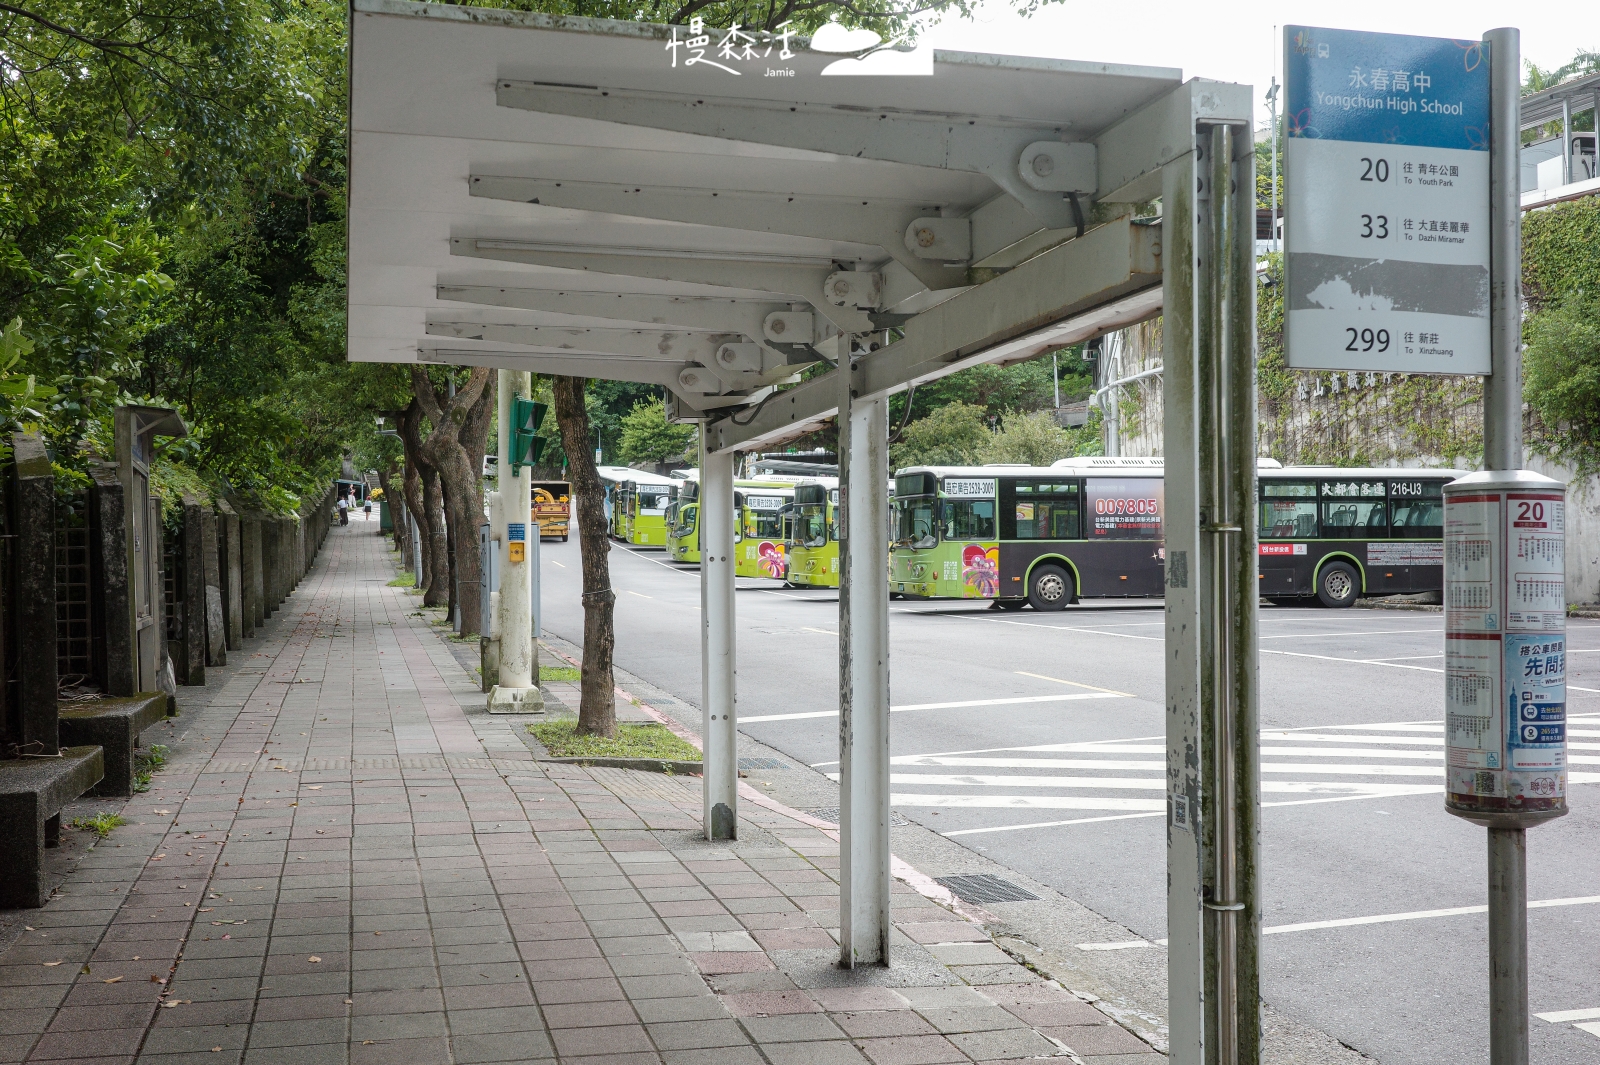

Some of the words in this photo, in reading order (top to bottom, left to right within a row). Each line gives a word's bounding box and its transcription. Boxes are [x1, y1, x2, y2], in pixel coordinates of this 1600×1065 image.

[1349, 66, 1431, 94] 永春高中
[1316, 91, 1384, 111] Yongchun
[1387, 97, 1417, 115] High
[1420, 99, 1463, 116] School
[1360, 157, 1389, 182] 20
[1403, 161, 1413, 174] 往
[1418, 163, 1459, 177] 青年公園
[1404, 176, 1412, 185] To
[1418, 177, 1437, 186] Youth
[1439, 178, 1454, 187] Park
[1360, 214, 1389, 239] 33
[1403, 218, 1414, 230] 往
[1418, 219, 1470, 234] 大直美麗華
[1404, 233, 1413, 241] To
[1418, 234, 1437, 243] Dazhi
[1438, 235, 1465, 244] Miramar
[1345, 327, 1390, 352] 299
[1404, 332, 1414, 343] 往
[1418, 332, 1440, 345] 新莊
[1405, 346, 1413, 354] To
[1419, 347, 1454, 357] Xinzhuang
[1321, 481, 1386, 496] 大都會客運
[1391, 482, 1422, 496] 216-U3
[1095, 498, 1158, 515] 009805
[1517, 501, 1544, 521] 20
